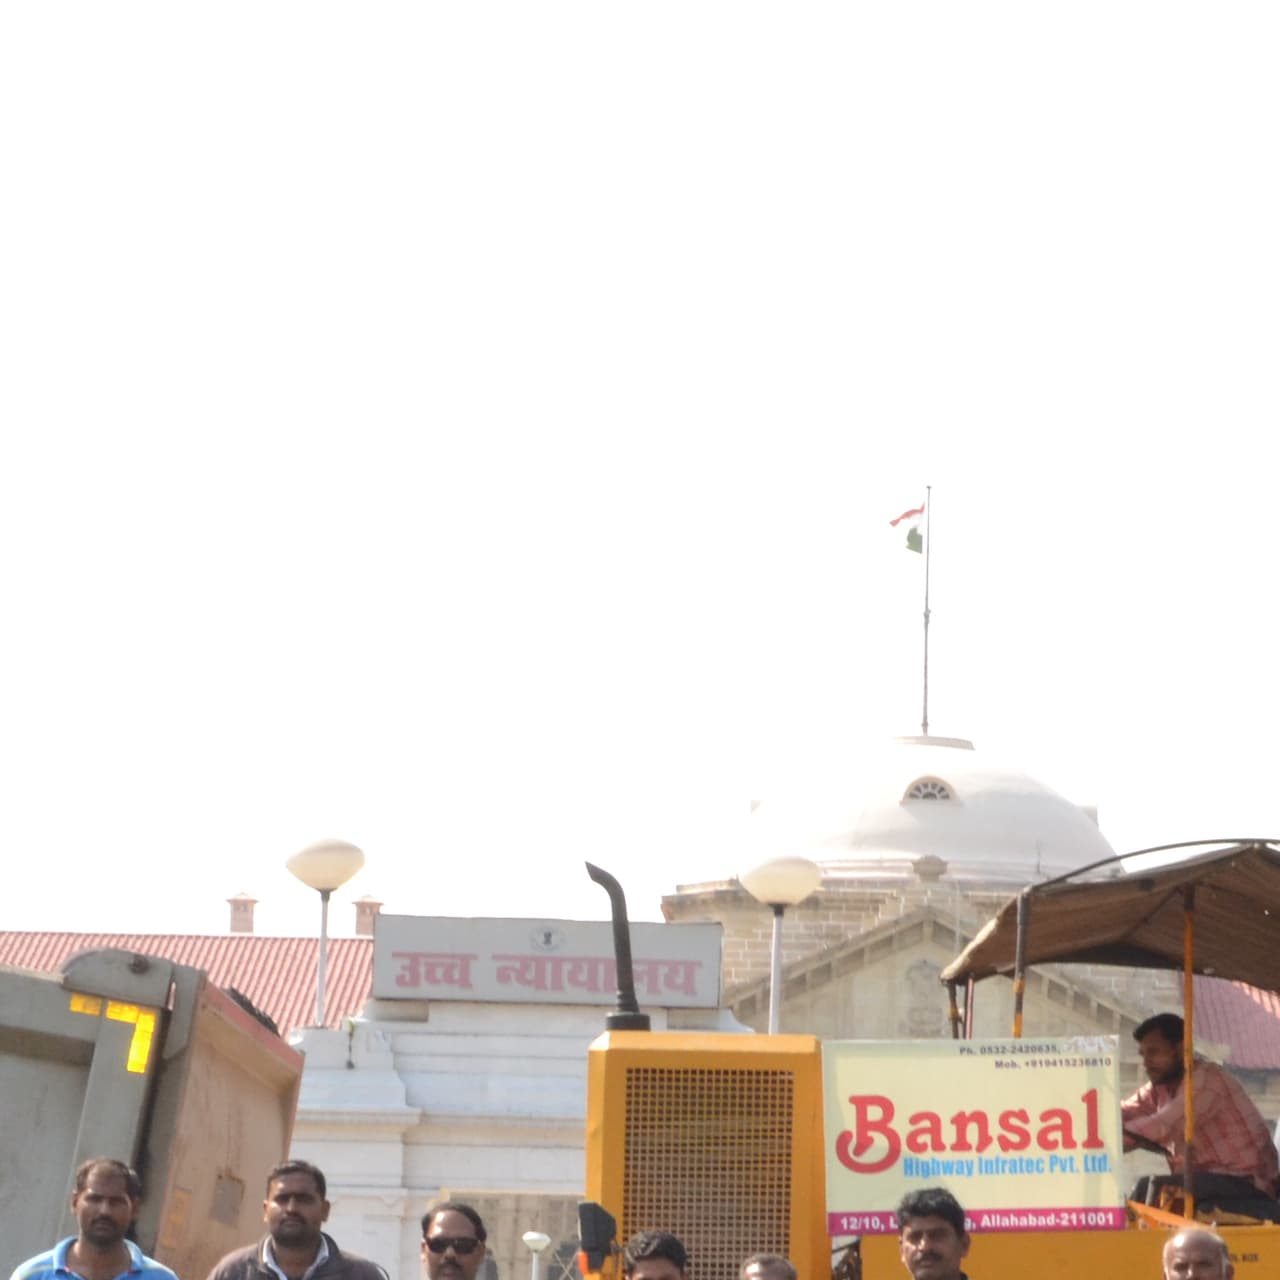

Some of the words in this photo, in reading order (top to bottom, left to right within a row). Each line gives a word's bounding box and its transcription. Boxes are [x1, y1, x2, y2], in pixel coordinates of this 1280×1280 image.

[835, 1088, 1105, 1174] Bansal
[903, 1156, 974, 1179] Highway
[978, 1154, 1044, 1175] Infratec
[1049, 1154, 1079, 1174] Pvt.
[1083, 1153, 1112, 1173] Ltd.
[840, 1215, 885, 1231] 12/10,
[981, 1212, 1114, 1228] Allahabad-211001
